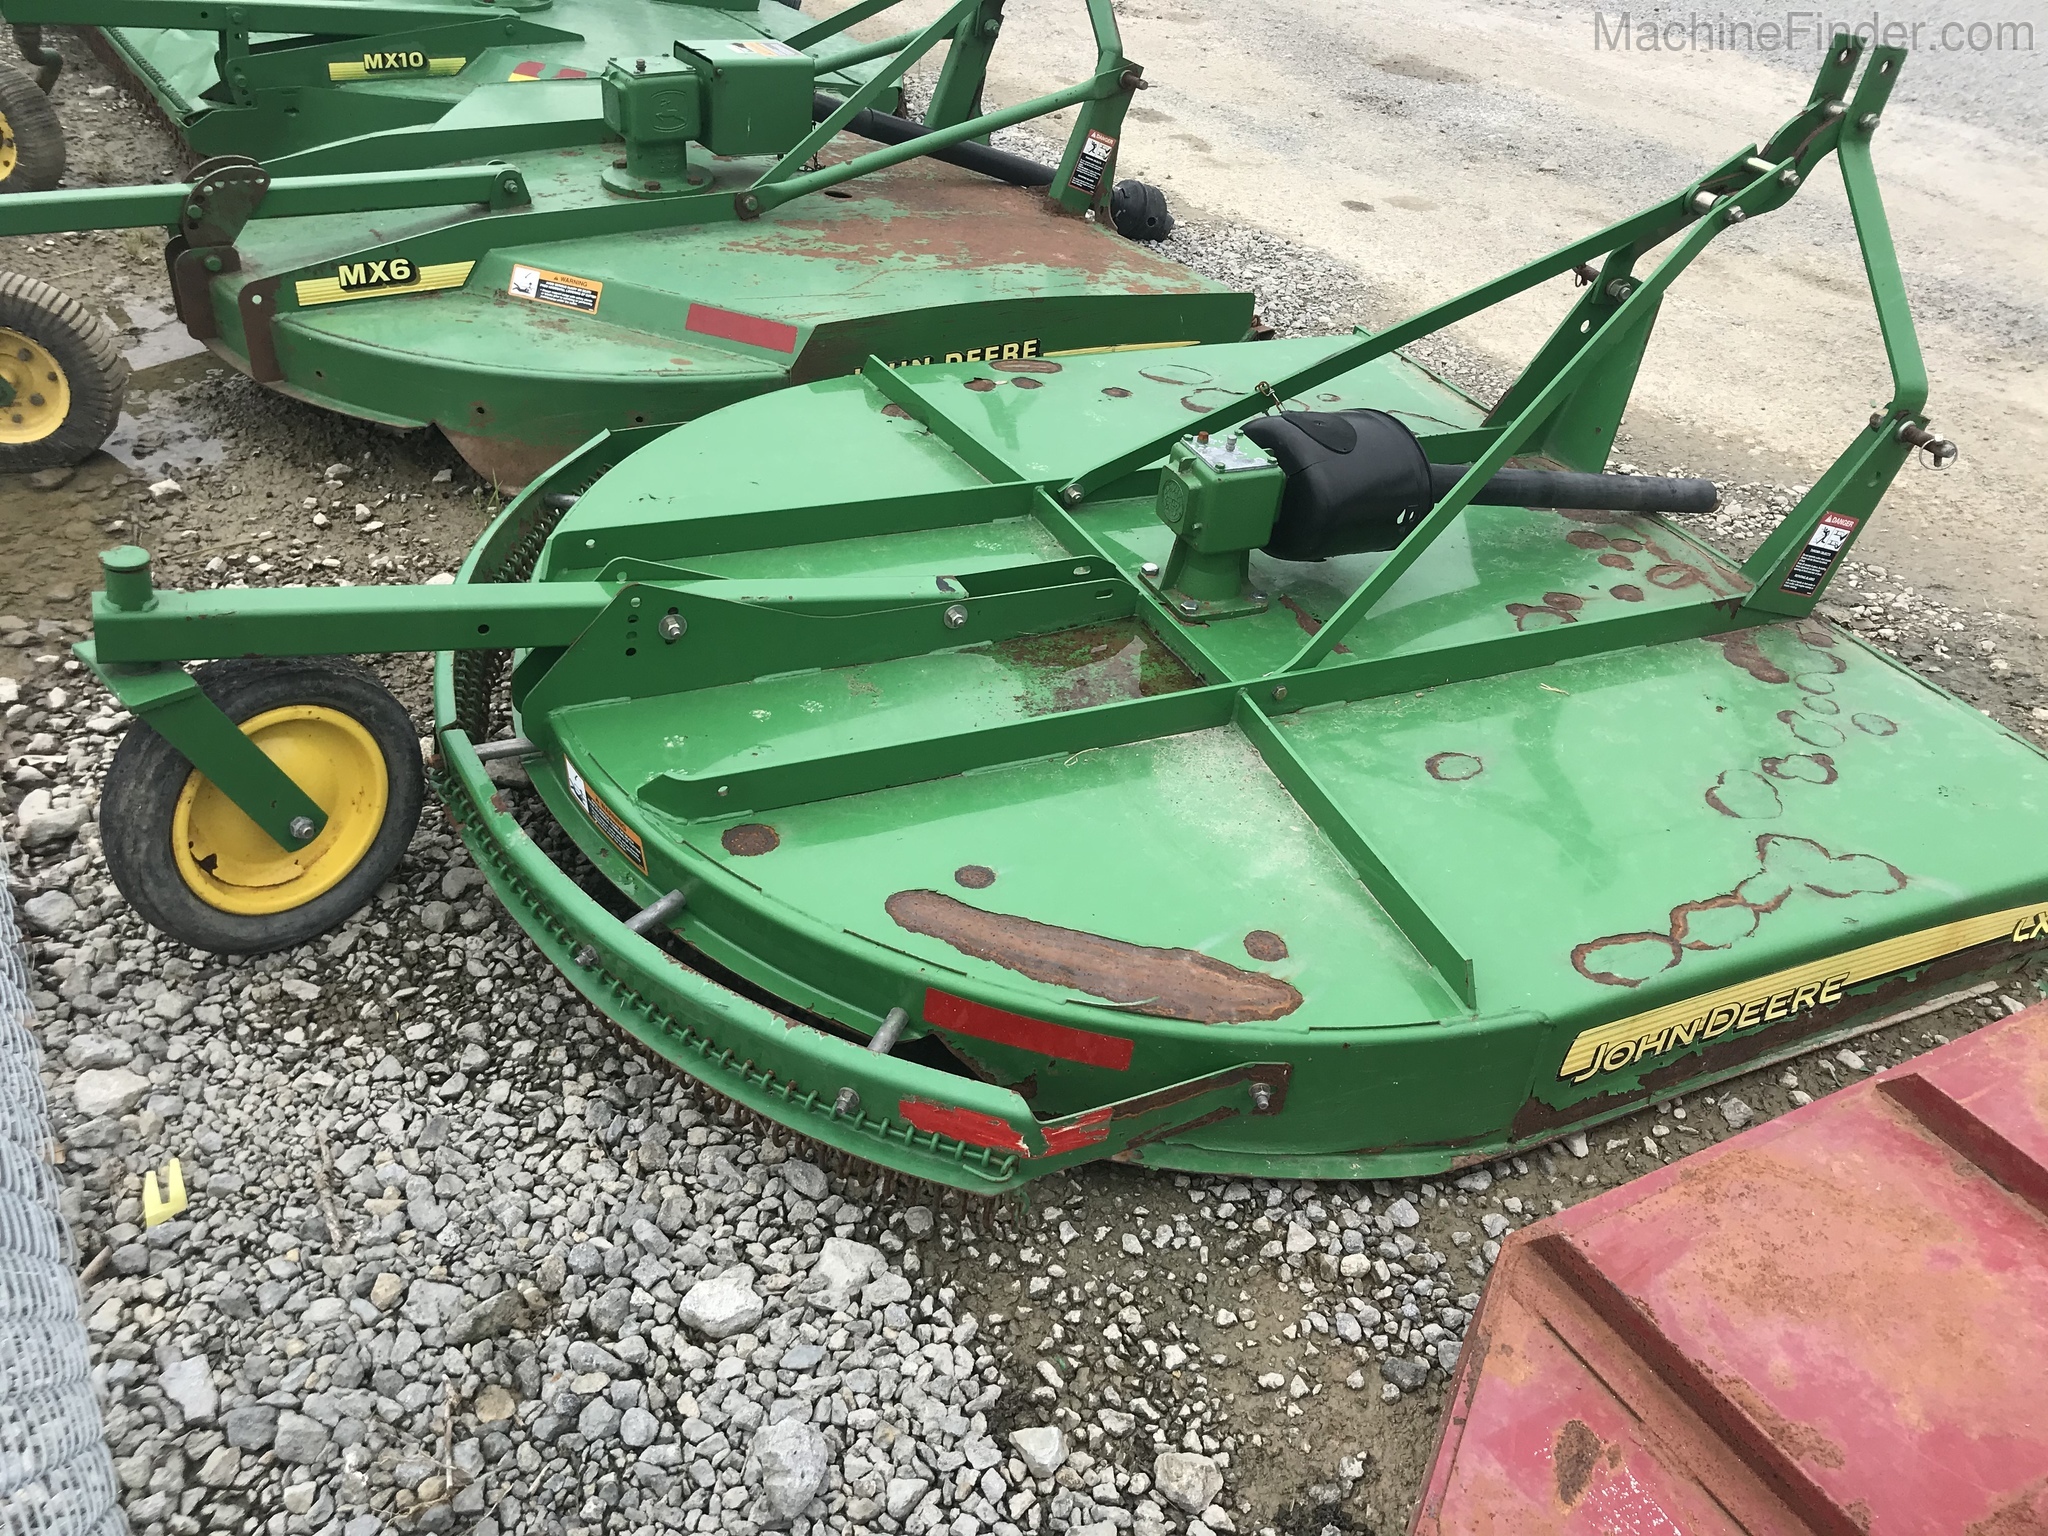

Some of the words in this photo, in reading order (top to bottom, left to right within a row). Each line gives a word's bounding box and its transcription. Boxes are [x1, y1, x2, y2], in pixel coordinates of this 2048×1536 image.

[363, 51, 425, 70] MX10
[338, 258, 412, 287] MX6
[560, 276, 588, 287] WARNING
[1831, 516, 1855, 528] DANGER
[1573, 1017, 1703, 1084] JOHN
[1700, 971, 1850, 1041] DEERE
